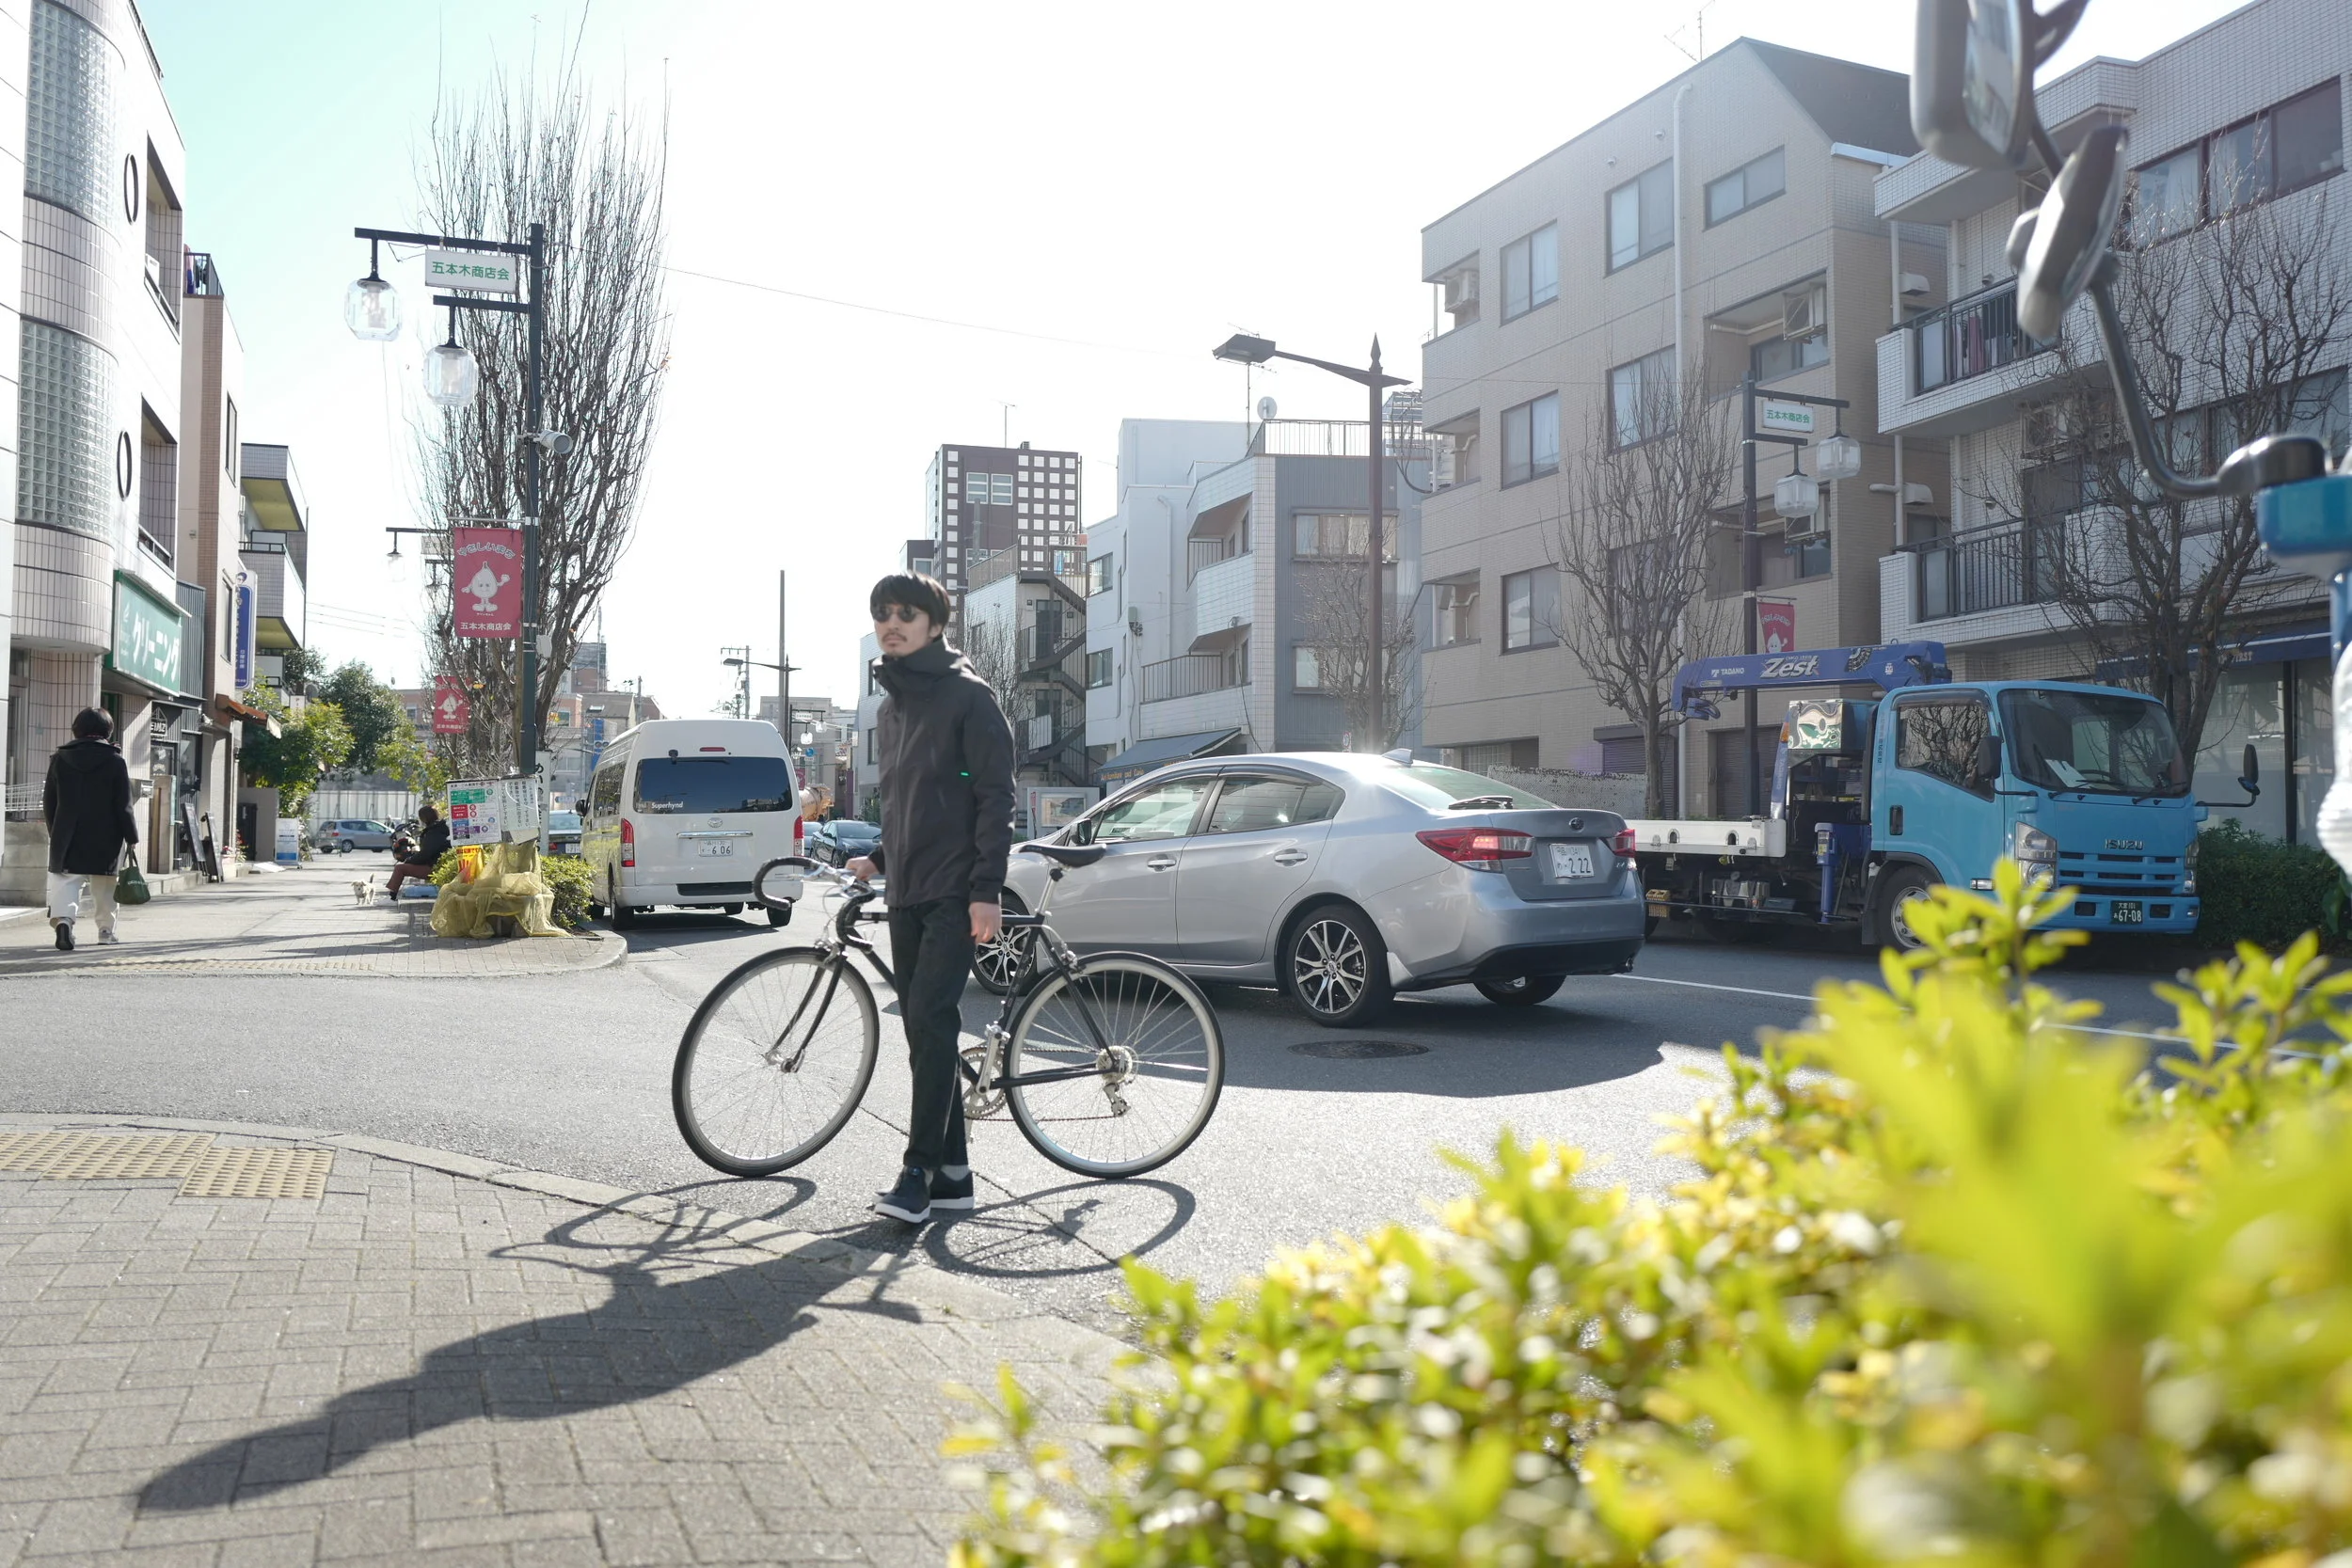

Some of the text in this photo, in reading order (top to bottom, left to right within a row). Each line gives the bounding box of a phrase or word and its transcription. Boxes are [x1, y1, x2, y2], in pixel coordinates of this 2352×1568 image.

[431, 260, 510, 281] 五本木商店会
[1766, 409, 1810, 424] 五本木商店会
[456, 542, 516, 560] やさしいまち
[460, 622, 512, 631] 五本木商店会
[133, 610, 180, 683] クリーニング
[2231, 651, 2253, 662] IRST
[1721, 655, 1820, 678] TADANO Zest
[651, 800, 684, 811] Superhynd
[2105, 839, 2144, 851] ISUZU
[2118, 910, 2142, 923] 67-08
